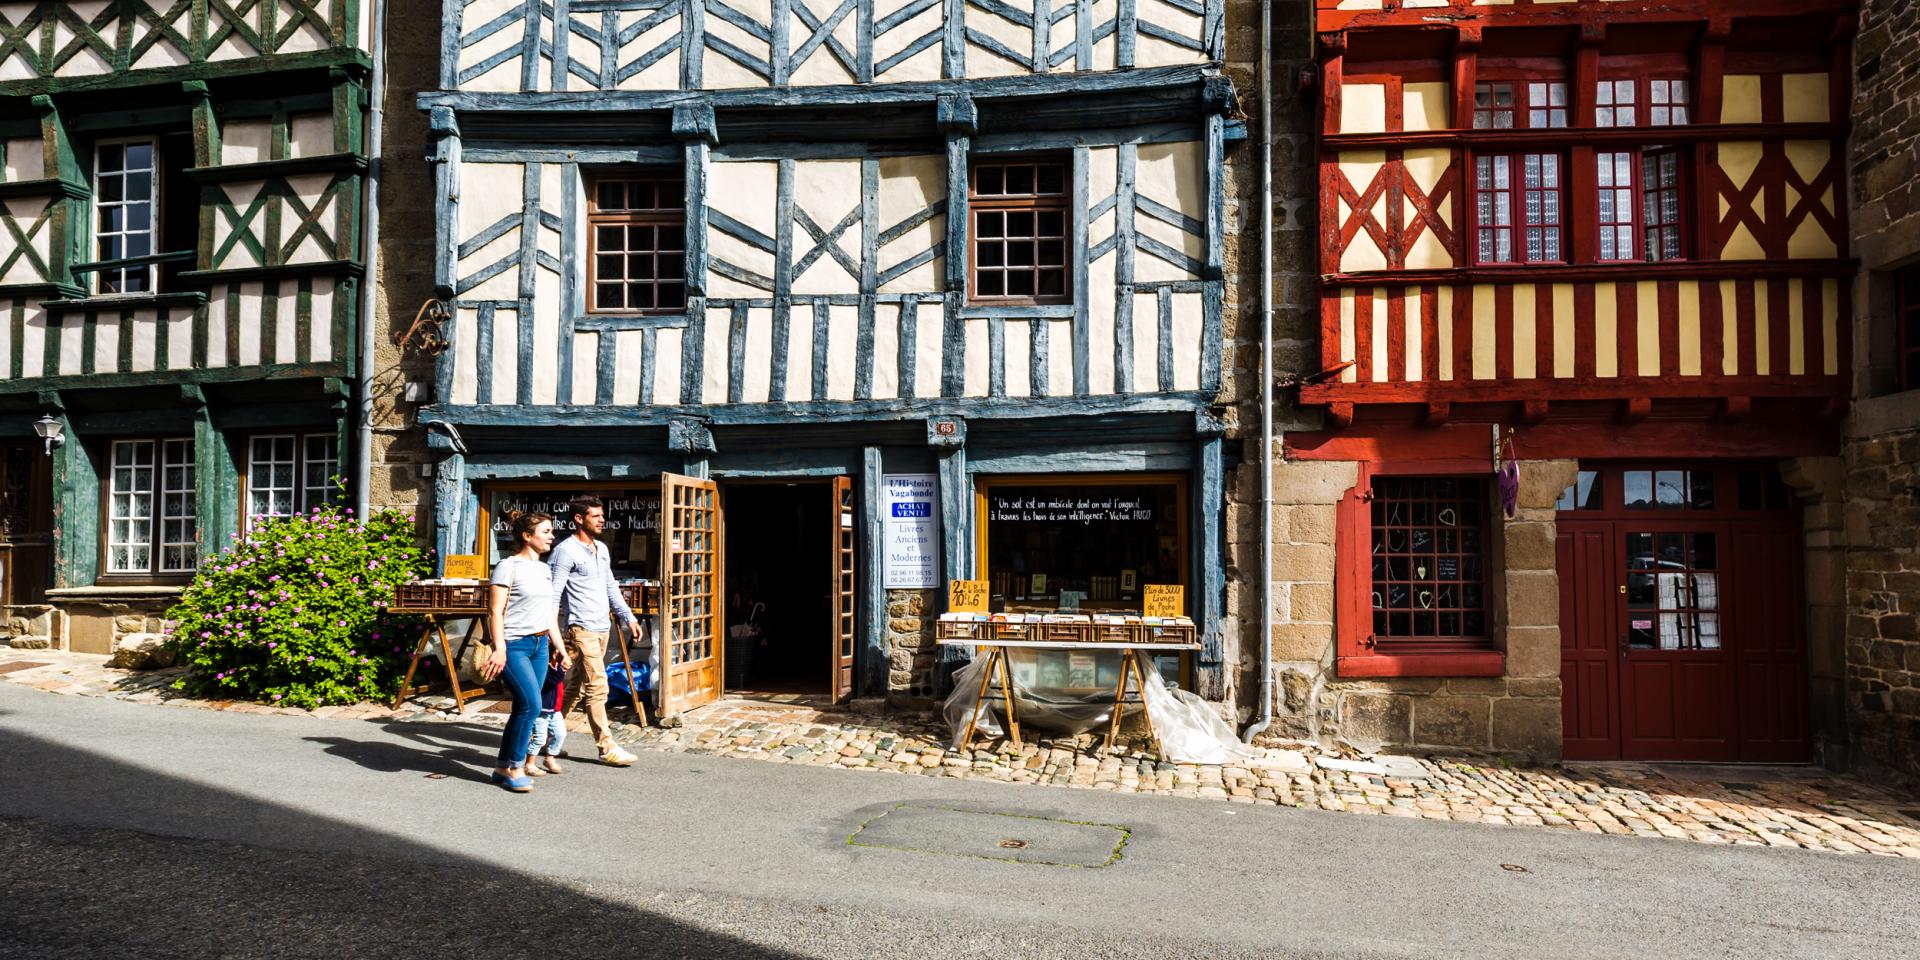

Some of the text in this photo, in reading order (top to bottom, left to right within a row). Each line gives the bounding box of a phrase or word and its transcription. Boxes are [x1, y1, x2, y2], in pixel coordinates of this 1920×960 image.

[940, 424, 952, 433] 65
[890, 479, 934, 488] L'Histoire
[889, 489, 934, 498] Vagabonde
[1011, 497, 1022, 509] sot
[1025, 497, 1036, 509] est
[1076, 498, 1090, 509] dont
[1022, 510, 1032, 521] les
[1049, 512, 1056, 521] de
[1132, 510, 1151, 520] HUGO
[899, 525, 925, 533] Livres
[896, 535, 928, 543] Anciens
[891, 553, 932, 562] Modernes
[1152, 594, 1175, 602] Livres
